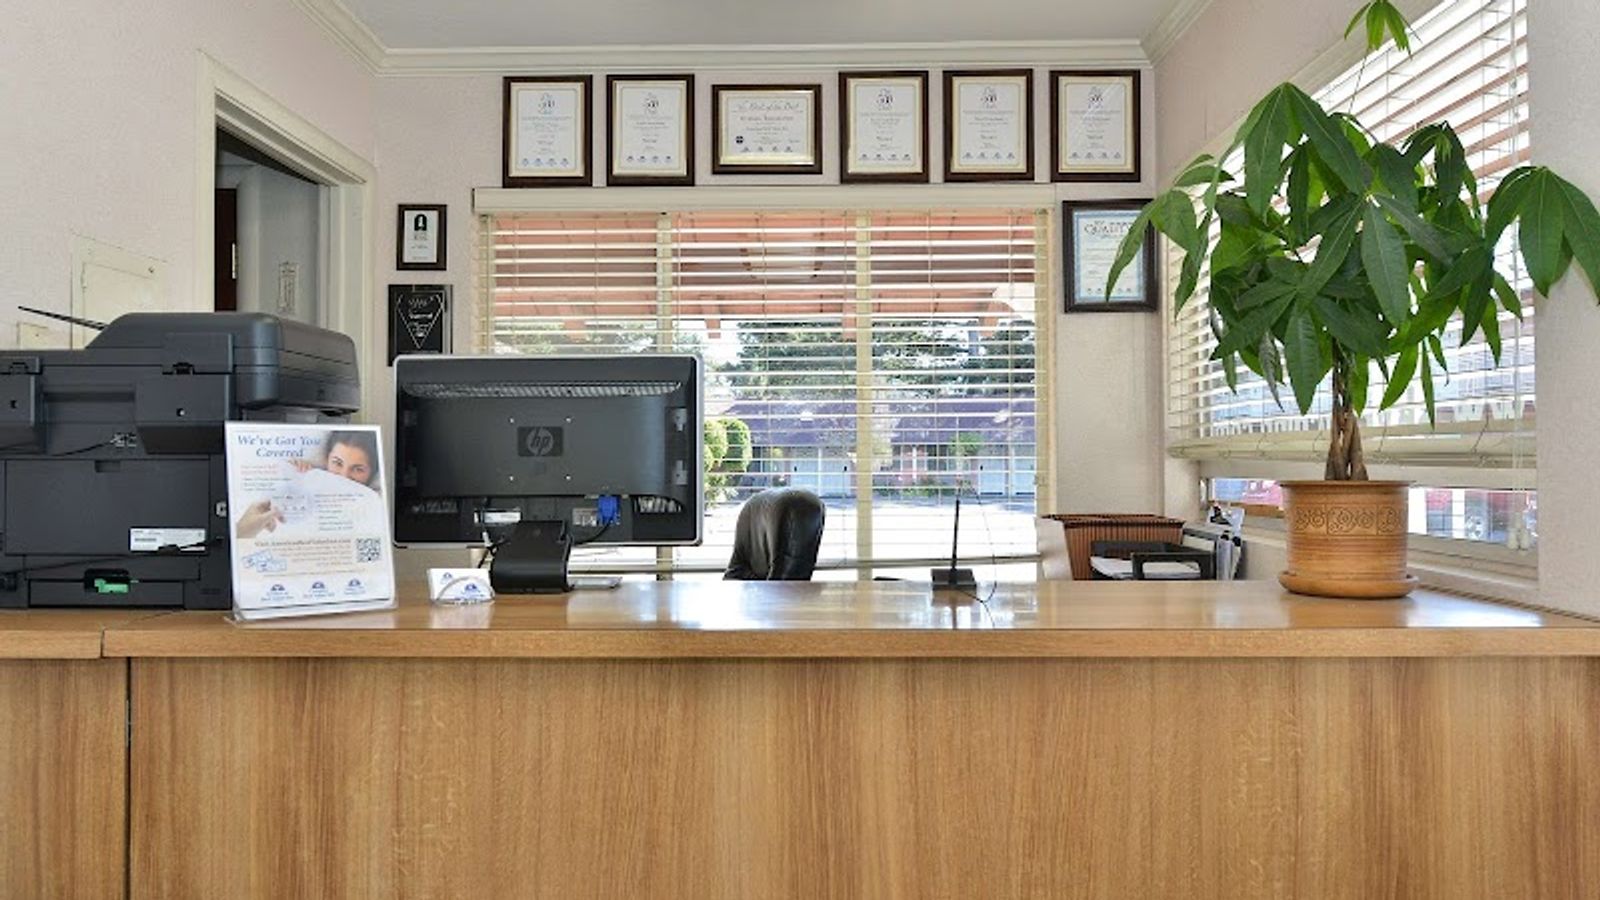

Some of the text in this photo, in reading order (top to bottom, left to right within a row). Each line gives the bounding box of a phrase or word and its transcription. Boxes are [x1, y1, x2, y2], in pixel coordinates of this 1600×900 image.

[238, 434, 321, 446] We've Got You
[529, 428, 553, 456] hp
[256, 447, 305, 458] Covered
